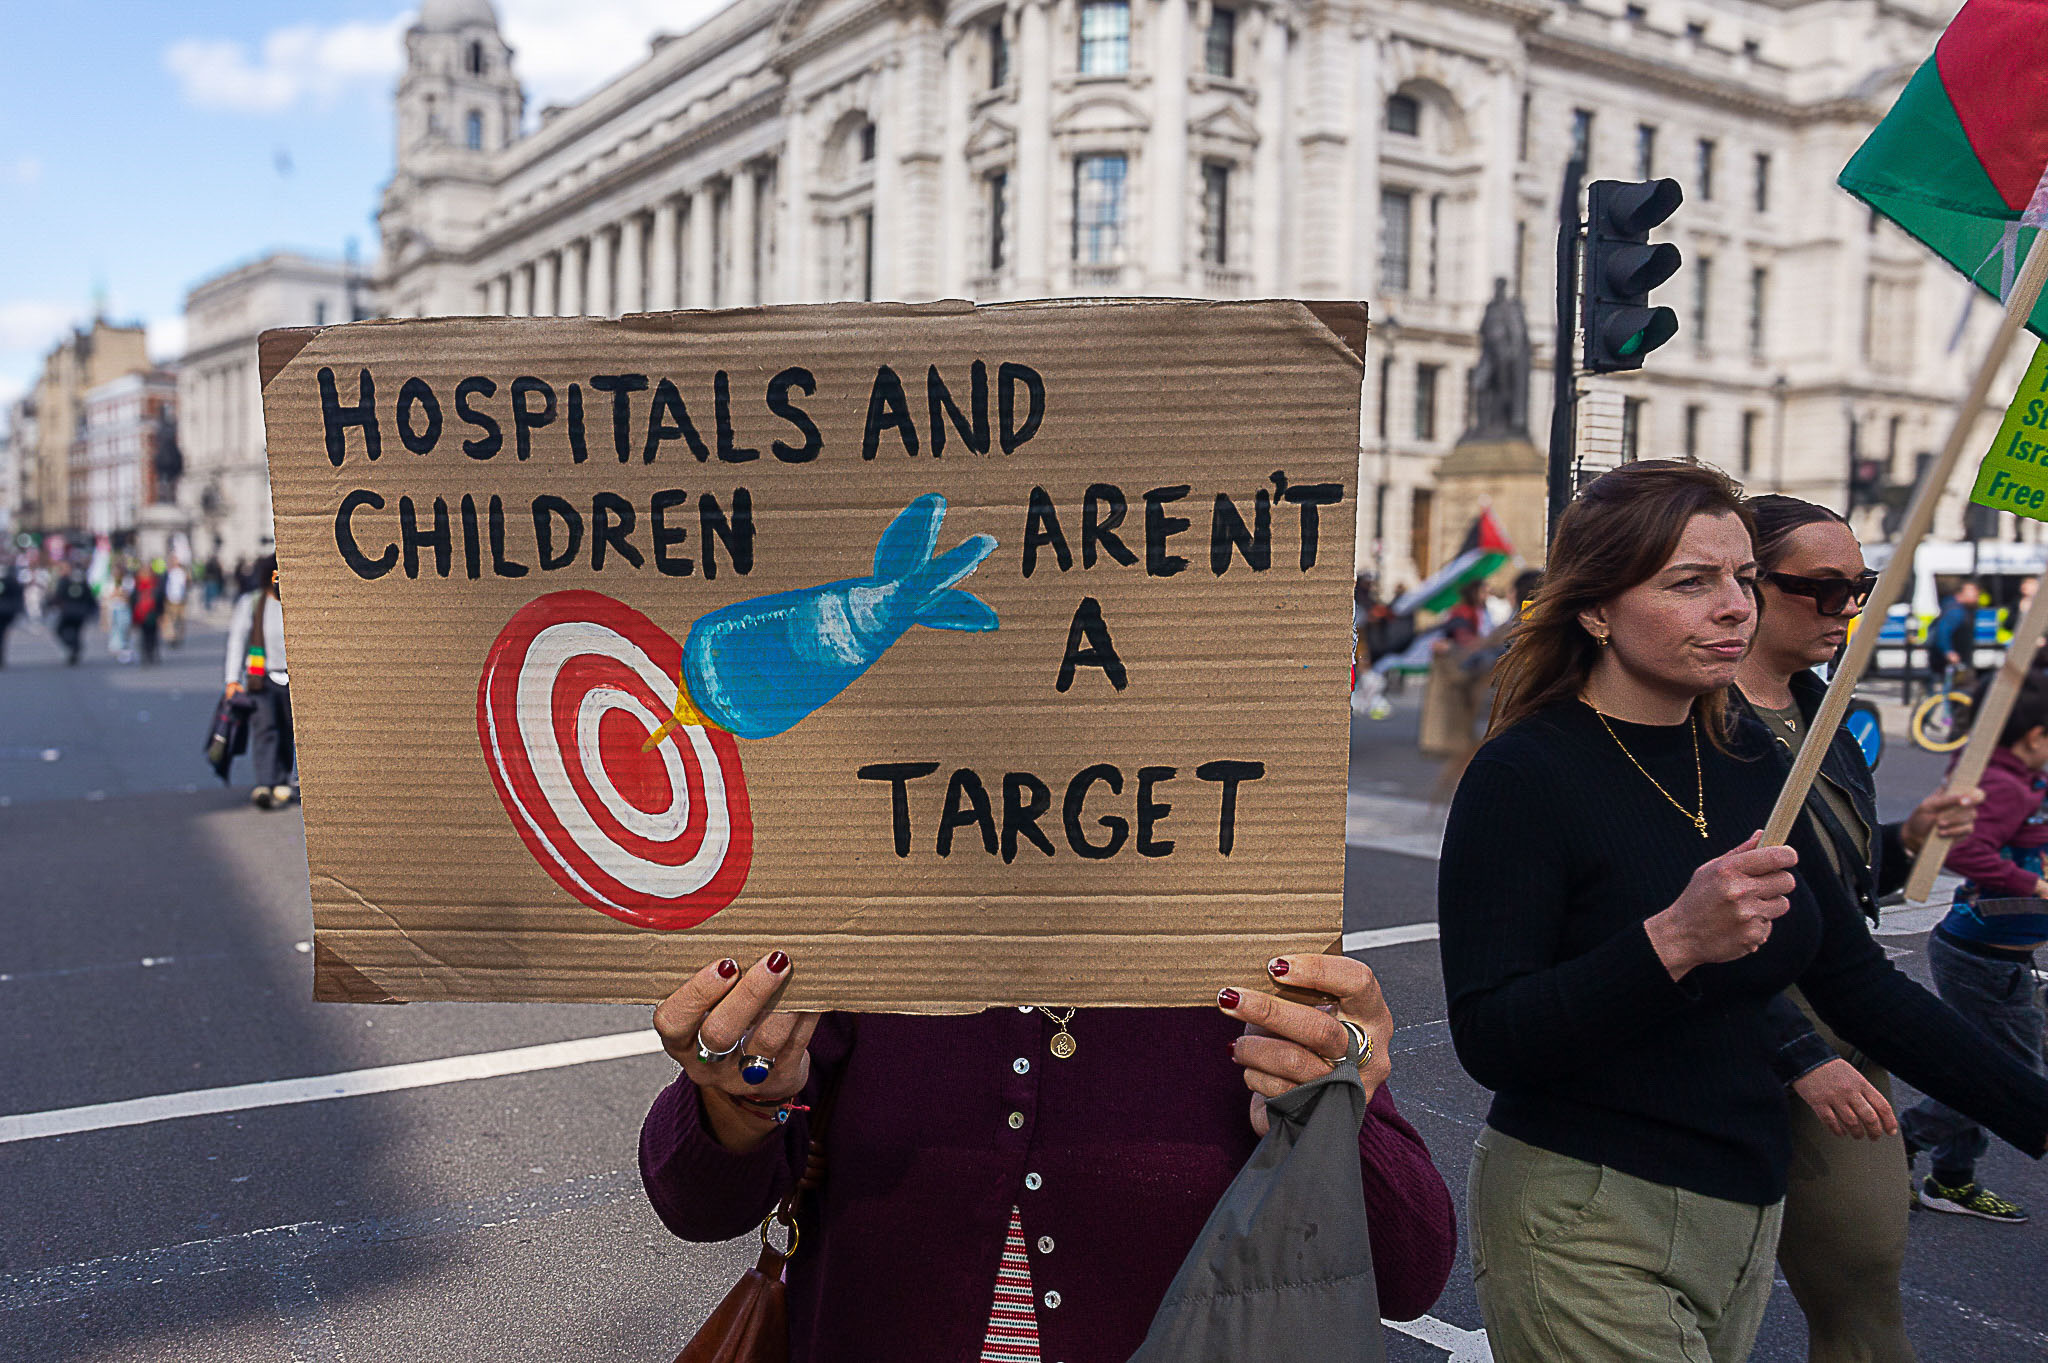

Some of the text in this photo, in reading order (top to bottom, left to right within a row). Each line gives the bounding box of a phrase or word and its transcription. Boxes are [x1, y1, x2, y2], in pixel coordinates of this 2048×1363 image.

[317, 359, 1046, 468] HOSPITALS AND
[334, 470, 1345, 581] CHILDREN AREN'T
[1987, 470, 2046, 510] Free
[1055, 596, 1129, 694] A
[856, 760, 1266, 867] TARGET
